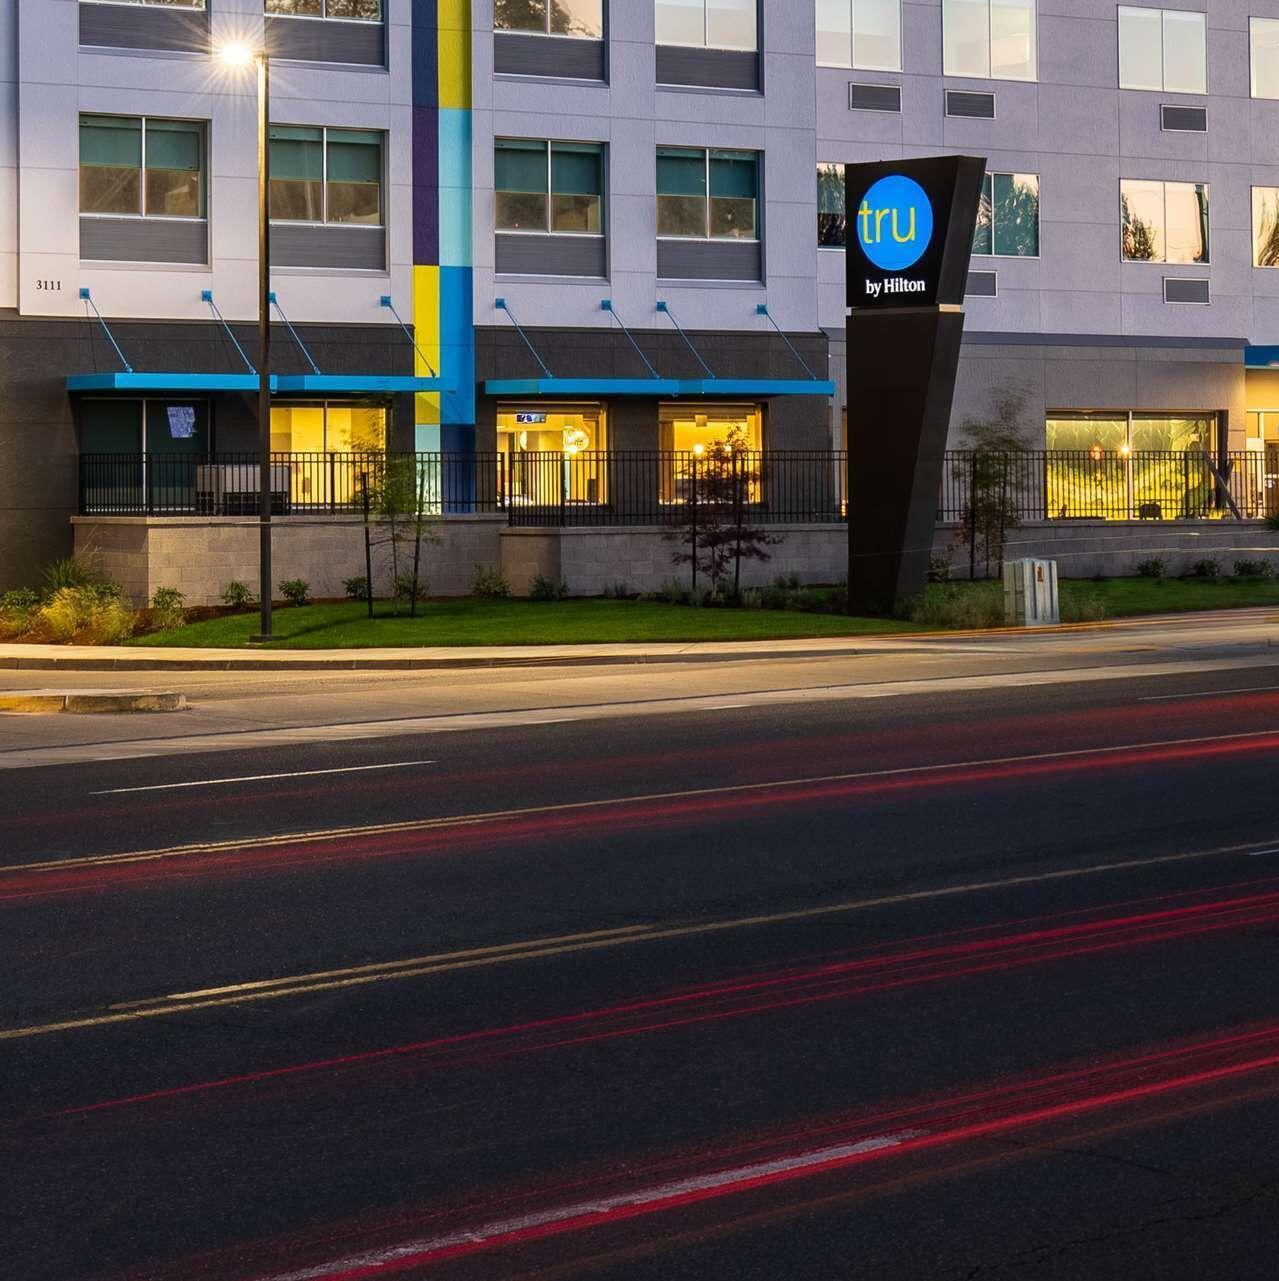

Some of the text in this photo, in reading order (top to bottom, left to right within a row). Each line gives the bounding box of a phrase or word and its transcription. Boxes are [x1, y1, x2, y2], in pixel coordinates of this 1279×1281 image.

[857, 200, 916, 244] tru
[36, 279, 61, 291] 3111
[865, 277, 926, 297] by Hilton
